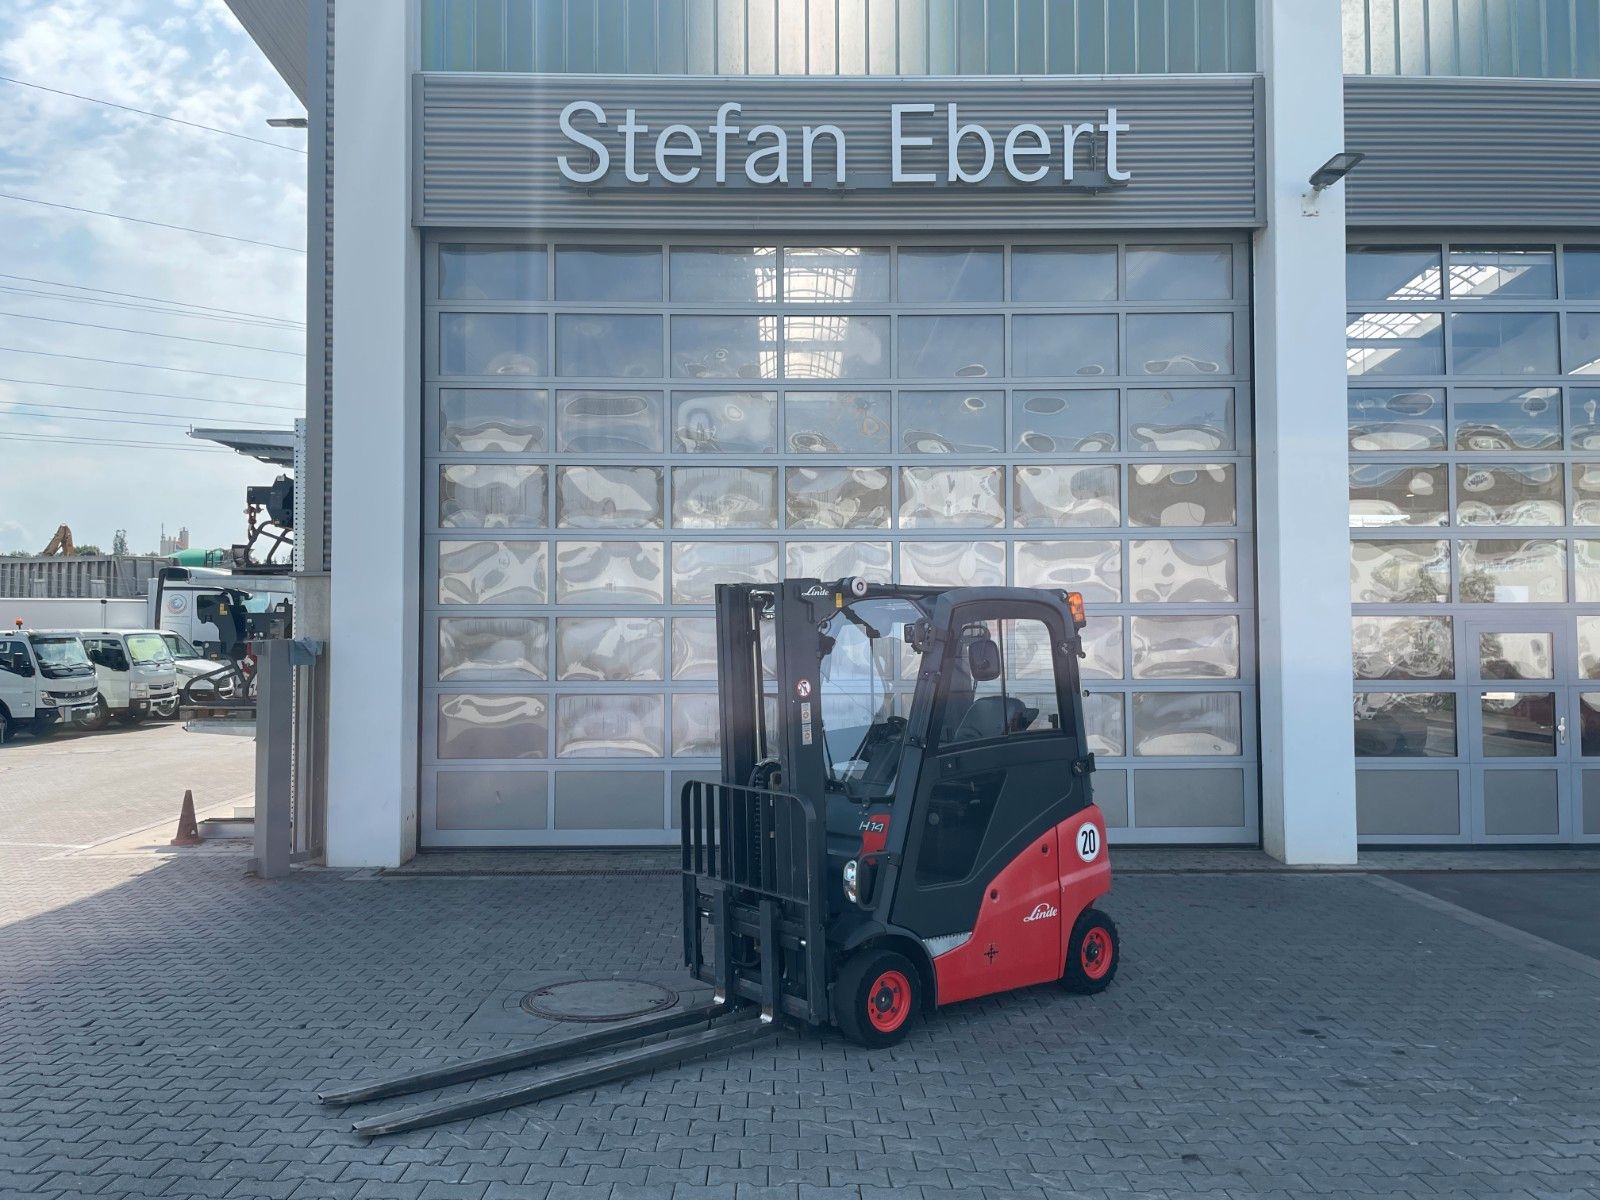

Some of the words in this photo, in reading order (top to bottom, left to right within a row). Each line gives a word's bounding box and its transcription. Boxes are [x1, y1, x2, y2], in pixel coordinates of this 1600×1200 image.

[556, 100, 846, 185] Stefan
[890, 101, 1132, 185] Ebert
[801, 585, 830, 596] Linde
[859, 821, 884, 832] H14
[1081, 829, 1096, 855] 20
[1023, 902, 1058, 923] Linde
